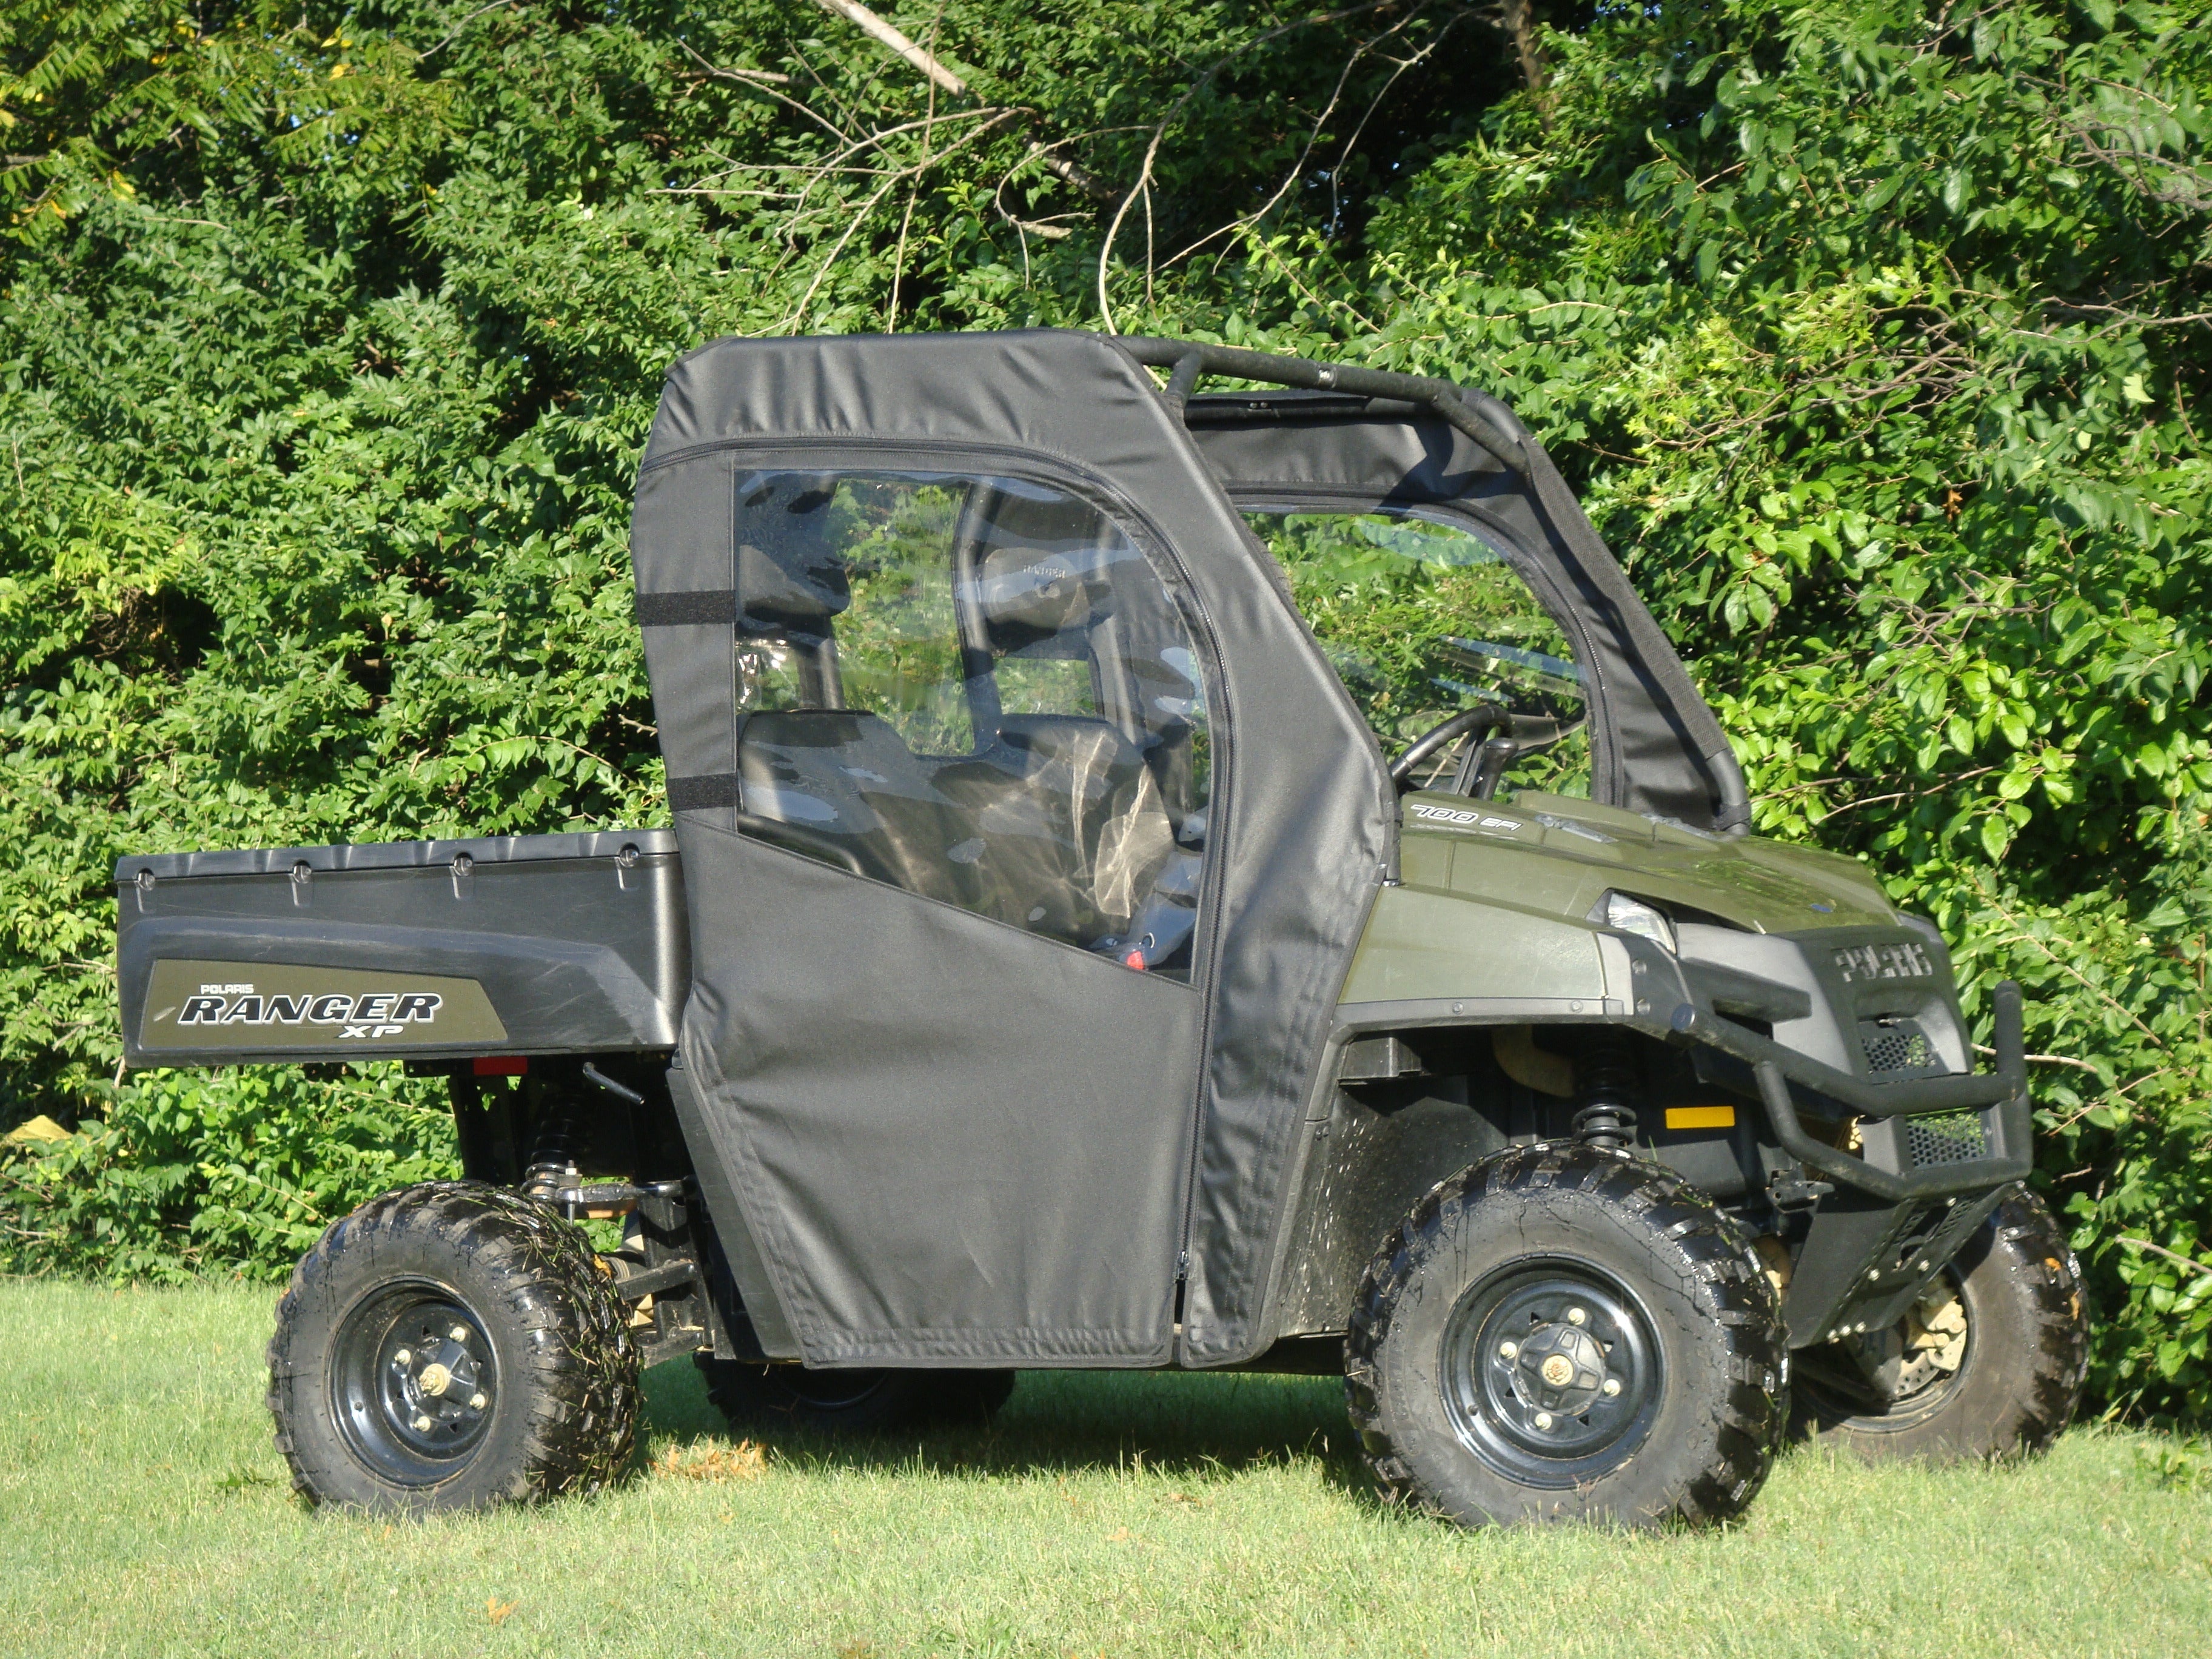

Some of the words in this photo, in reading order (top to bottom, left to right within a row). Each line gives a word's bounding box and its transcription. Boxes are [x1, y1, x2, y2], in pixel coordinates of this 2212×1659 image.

[1410, 805, 1479, 824] 700
[1480, 817, 1523, 831] EFI
[201, 984, 253, 994] POLARIS
[178, 993, 443, 1024] RANGER
[337, 1025, 404, 1038] XP
